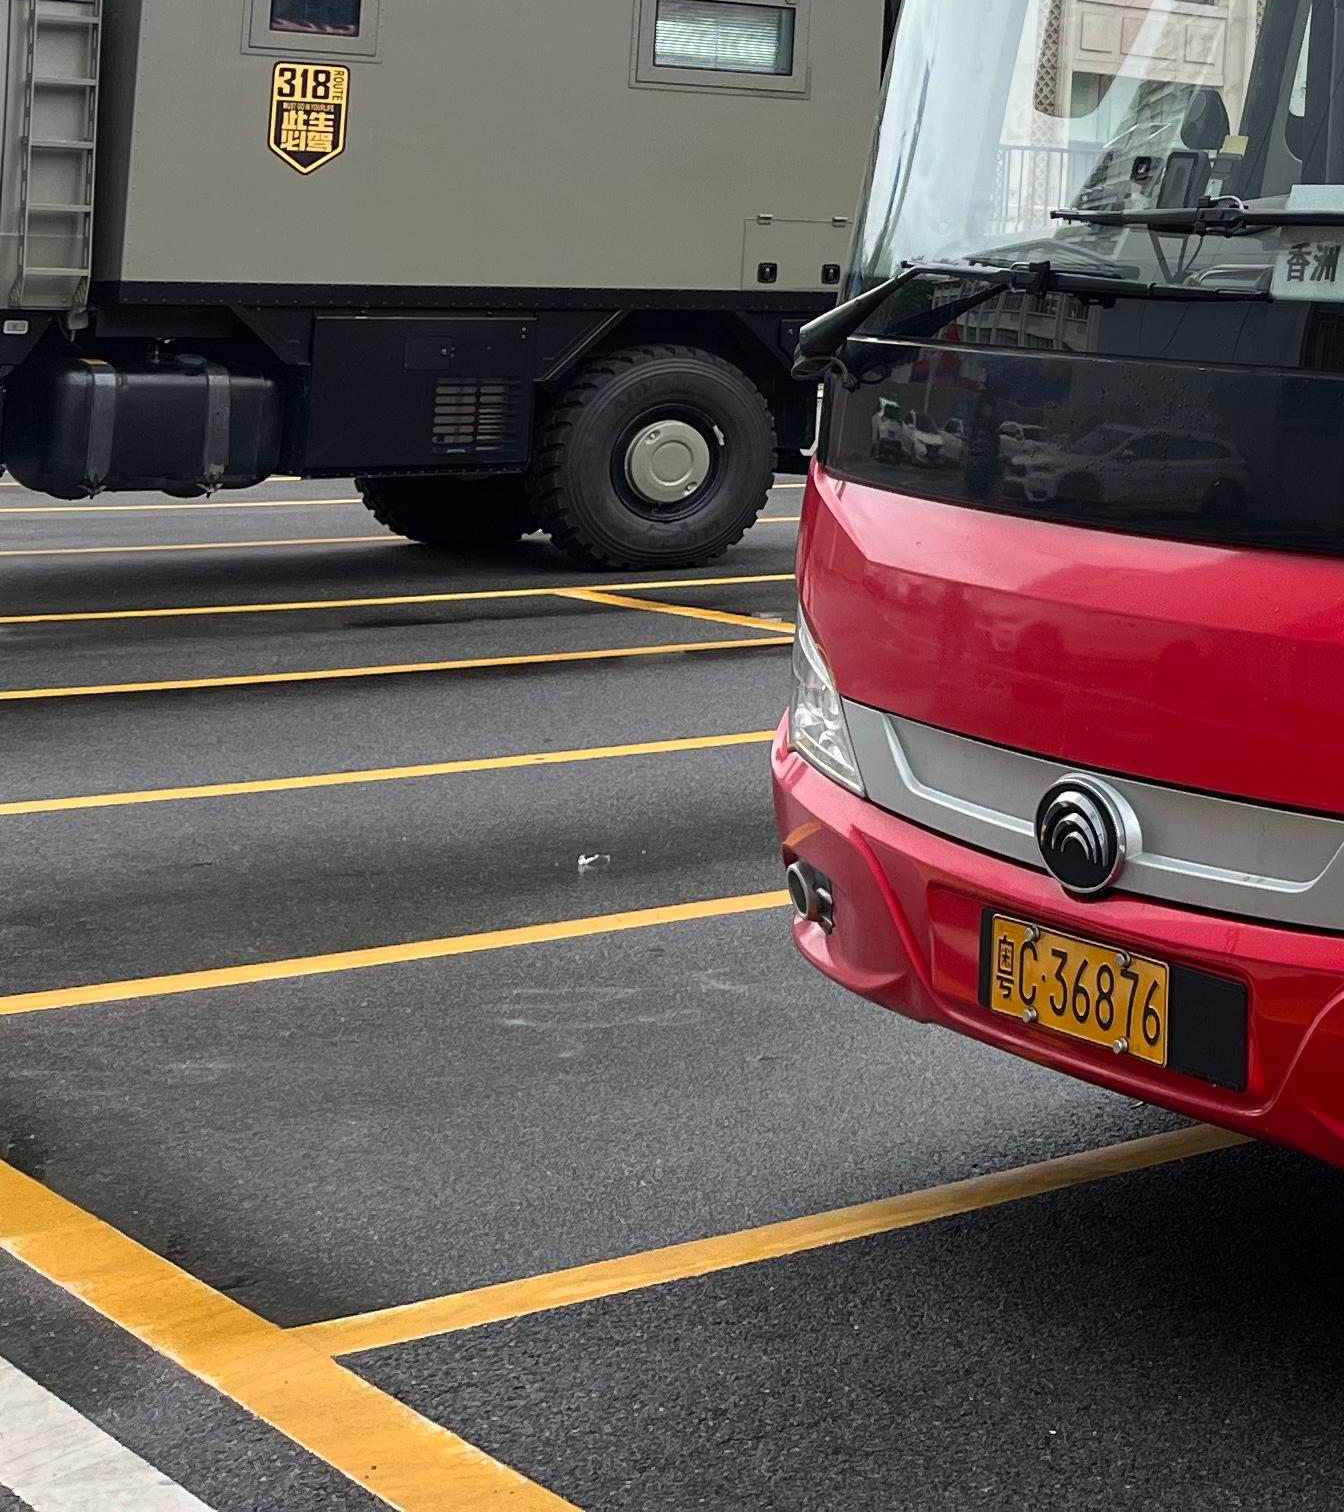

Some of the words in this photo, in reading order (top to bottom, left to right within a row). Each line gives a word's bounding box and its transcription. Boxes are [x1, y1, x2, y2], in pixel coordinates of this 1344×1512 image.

[277, 67, 331, 99] 318
[332, 69, 345, 101] ROUTE
[282, 110, 334, 132] 此生
[279, 130, 334, 153] 必驾
[1285, 242, 1342, 283] 香洲
